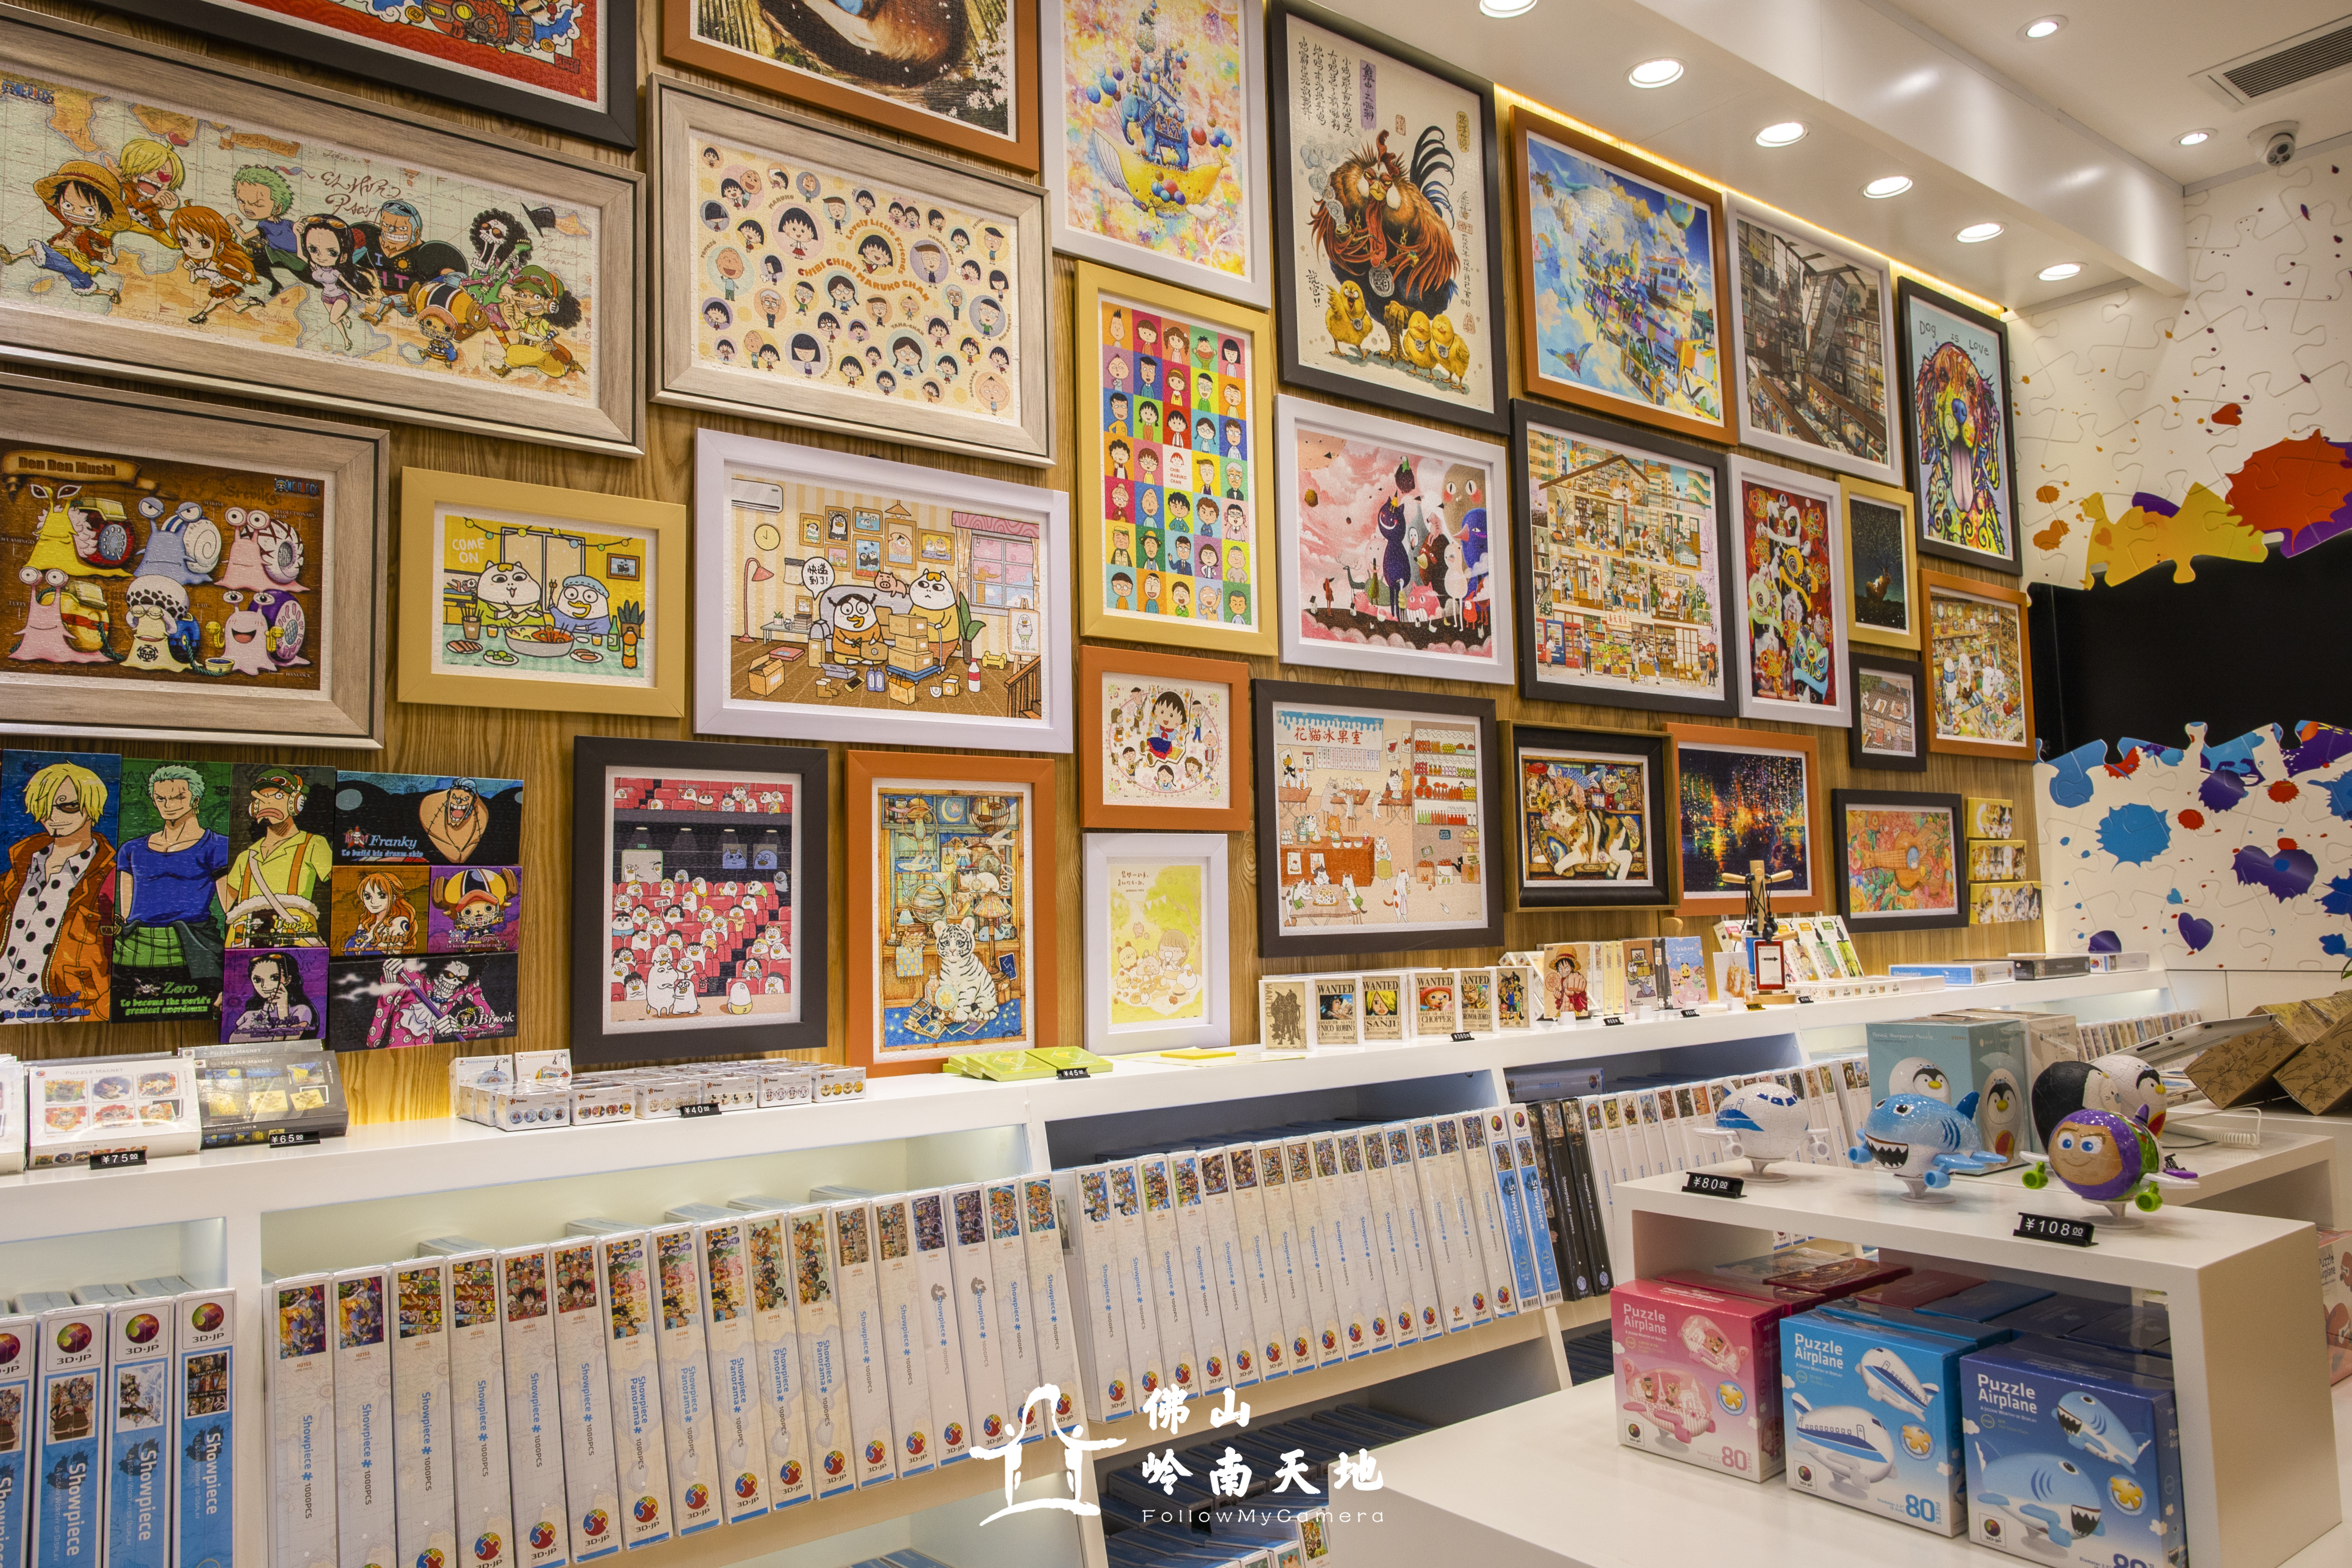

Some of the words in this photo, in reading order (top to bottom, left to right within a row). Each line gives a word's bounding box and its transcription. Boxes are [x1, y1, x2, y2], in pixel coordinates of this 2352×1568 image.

[769, 194, 794, 209] MARUKO
[846, 219, 868, 240] Lovely
[870, 219, 895, 236] Little
[894, 237, 906, 275] Friends
[798, 261, 826, 277] CHIBI
[826, 258, 857, 275] CHIBI
[856, 272, 900, 291] MARUKO
[903, 280, 929, 302] CHAN
[19, 456, 43, 469] Den
[48, 460, 73, 472] Den
[77, 462, 116, 476] Mushi
[452, 538, 485, 550] COME
[459, 552, 479, 564] ON
[808, 563, 828, 575] 快递
[1294, 727, 1363, 744] 花貓冰果室
[369, 835, 417, 849] Franky
[274, 919, 313, 931] Usopp
[371, 932, 409, 943] Nami
[41, 991, 81, 1004] Sanji
[163, 982, 198, 994] Zoro
[1317, 984, 1354, 994] WANTED
[1363, 981, 1398, 990] WANTED
[1417, 977, 1453, 986] WANTED
[478, 1012, 514, 1025] Brook
[1531, 1180, 1545, 1230] Showpiece
[1562, 1176, 1571, 1208] Showpiece
[1436, 1202, 1446, 1234] Showpiece
[1508, 1185, 1522, 1235] Showpiece
[1283, 1232, 1292, 1267] Showpiece
[1360, 1217, 1370, 1251] Showpiece
[1195, 1246, 1205, 1283] Showpiece
[1102, 1265, 1111, 1304] Showpiece
[976, 1289, 985, 1331] Showpiece
[1623, 1303, 1666, 1323] Puzzle
[1624, 1315, 1667, 1335] Airplane
[859, 1311, 869, 1355] Showpiece
[1795, 1332, 1843, 1356] Puzzle
[779, 1348, 789, 1392] Showpiece
[823, 1340, 833, 1384] Showpiece
[1795, 1346, 1844, 1370] Airplane
[688, 1366, 698, 1413] Showpiece
[736, 1357, 747, 1403] Showpiece
[1978, 1374, 2036, 1400] Puzzle
[477, 1380, 487, 1431] Showpiece
[530, 1373, 540, 1423] Showpiece
[629, 1378, 641, 1425] Panorama
[637, 1376, 648, 1424] Showpiece
[1978, 1388, 2037, 1415] Airplane
[302, 1415, 312, 1470] Showpiece
[361, 1403, 372, 1458] Showpiece
[481, 1443, 489, 1477] 1000PCS
[533, 1435, 542, 1467] 1000PCS
[1721, 1446, 1747, 1472] 80
[202, 1433, 221, 1515] Showpiece
[63, 1462, 86, 1557] Showpiece
[135, 1449, 158, 1541] Showpiece
[1905, 1494, 1935, 1522] 80
